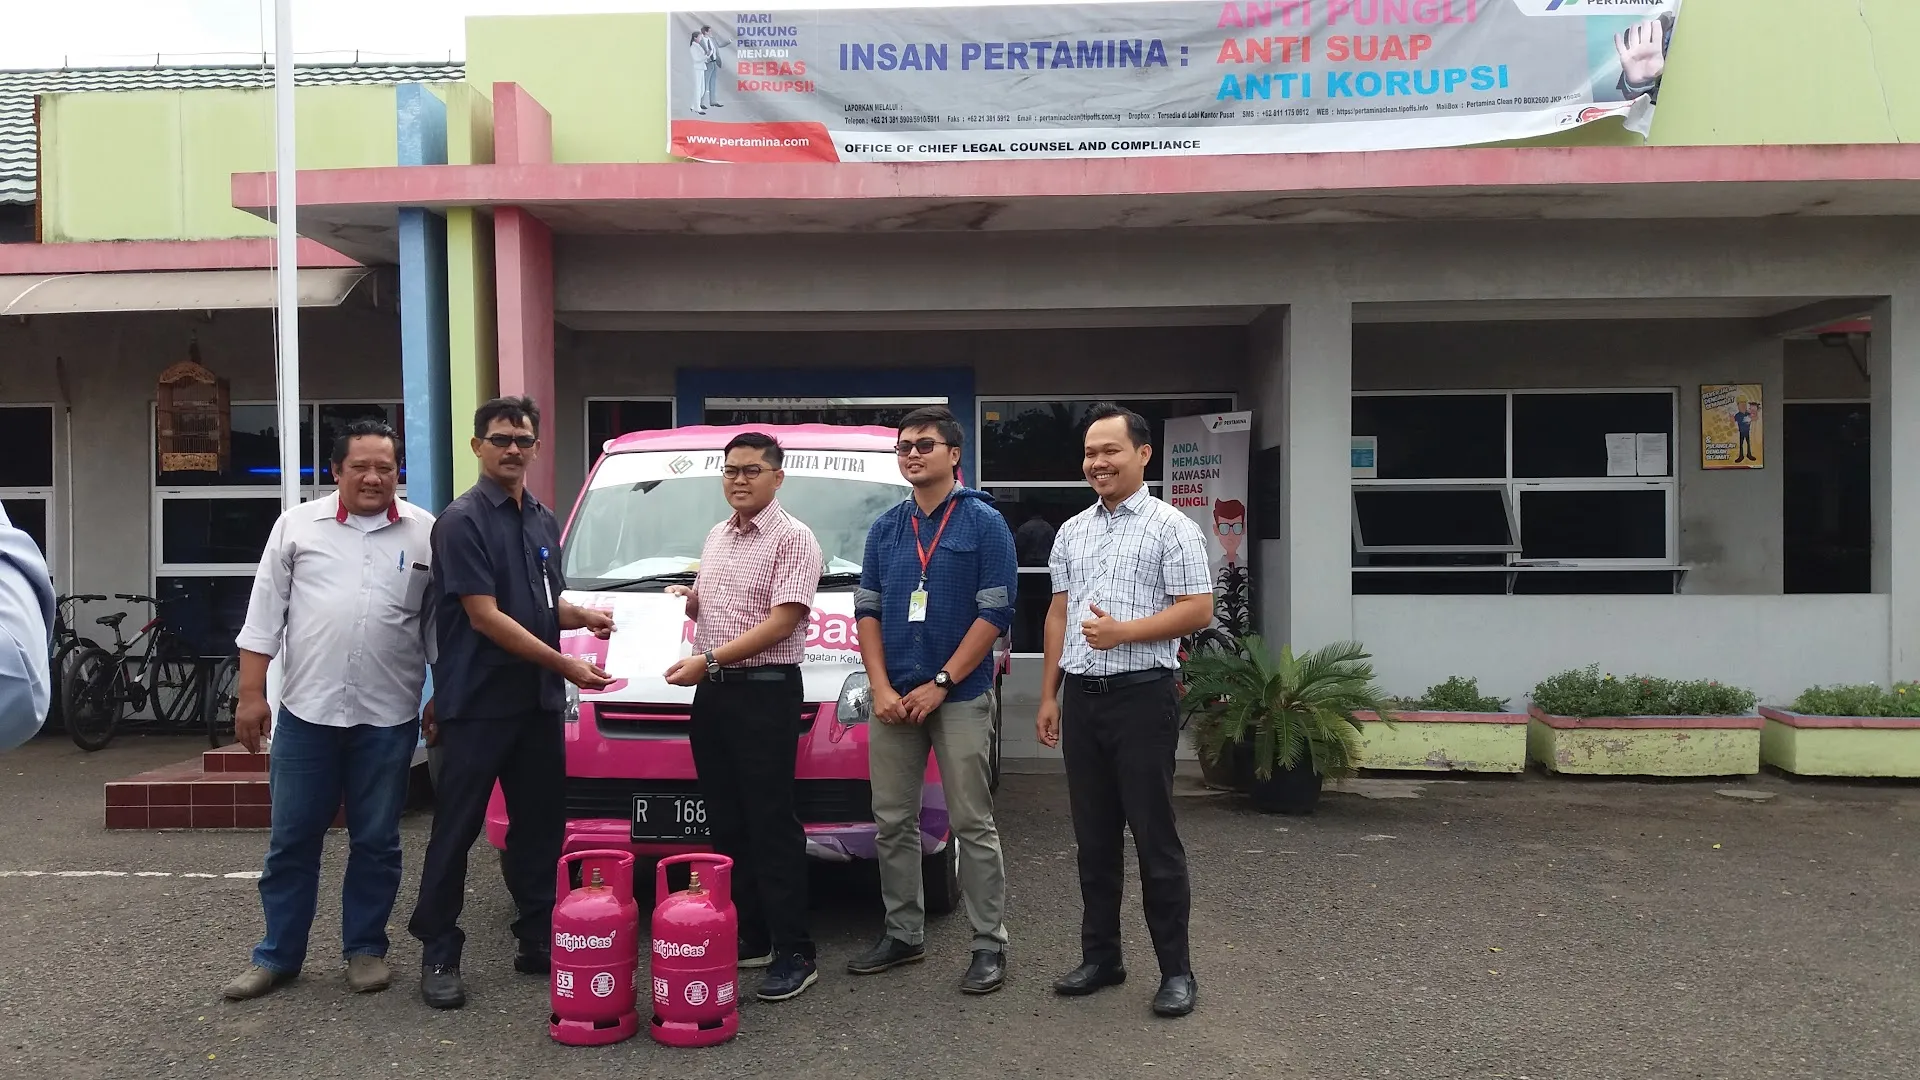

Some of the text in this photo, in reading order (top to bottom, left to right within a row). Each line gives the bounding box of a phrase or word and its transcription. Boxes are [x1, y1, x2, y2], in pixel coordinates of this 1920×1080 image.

[737, 13, 772, 23] MARI
[1217, 0, 1478, 28] ANTI PUNGLI
[737, 26, 797, 36] DUKUNG
[737, 39, 798, 47] PERTAMINA
[1216, 34, 1433, 64] ANTI SUAP
[737, 49, 789, 58] MENJADI
[839, 43, 948, 71] INSAN
[961, 39, 1169, 70] PERTAMINA
[737, 60, 806, 76] BEBAS
[1216, 64, 1509, 100] ANTI KORUPSI
[844, 104, 874, 112] LAPORKAN
[874, 103, 898, 111] MELALUI
[870, 116, 880, 124] +62
[889, 116, 899, 124] 381
[947, 115, 960, 123] Faks
[967, 115, 977, 123] +62
[997, 114, 1010, 122] 5912
[1017, 114, 1032, 122] Email
[1128, 112, 1150, 121] Dropbox
[1187, 111, 1200, 119] Lobi
[1200, 111, 1219, 119] Kantor
[1219, 111, 1235, 119] Pusat
[1242, 110, 1254, 118] SMS
[1273, 109, 1283, 117] 811
[1316, 108, 1329, 116] WEB
[1466, 99, 1496, 108] Pertamina
[1496, 98, 1513, 106] Clean
[1514, 97, 1523, 105] PO
[1550, 95, 1562, 103] JKP
[686, 135, 810, 148] www.pertamina.com
[844, 140, 1201, 153] OFFICE OF CHIEF LEGAL COUNSEL AND COMPLIANCE
[1171, 442, 1199, 454] ANDA
[784, 454, 820, 470] TIRTA
[823, 456, 865, 473] PUTRA
[1171, 454, 1222, 467] MEMASUKI
[1171, 468, 1220, 481] KAWASAN
[1171, 483, 1203, 495] BEBAS
[1172, 496, 1209, 507] PUNGLI
[804, 652, 862, 665] ngatan Kelu
[636, 799, 648, 823] R
[556, 932, 612, 951] Bright Gas
[653, 939, 705, 958] Bright Gas
